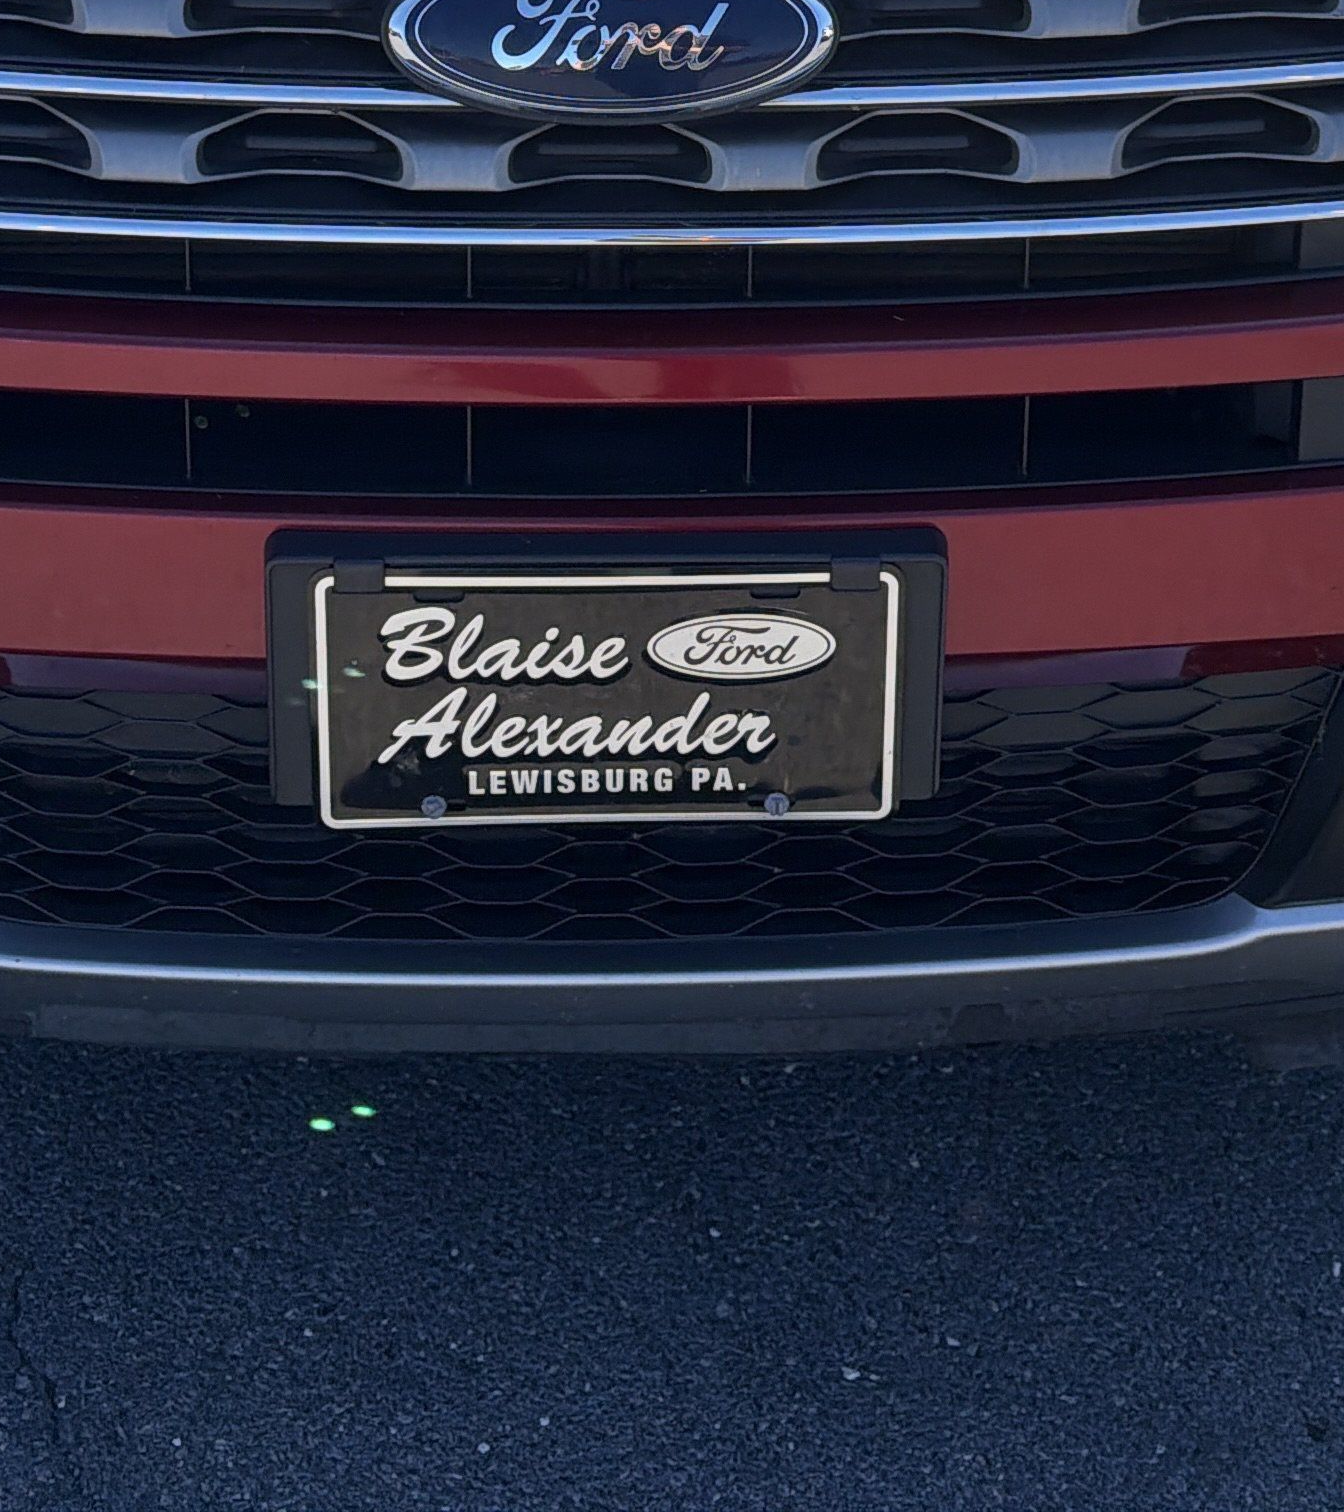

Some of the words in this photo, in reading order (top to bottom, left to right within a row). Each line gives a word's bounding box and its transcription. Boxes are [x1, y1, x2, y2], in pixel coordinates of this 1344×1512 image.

[379, 606, 630, 680] Blaise
[683, 625, 798, 667] Ford
[378, 687, 777, 764] Alexander
[468, 768, 674, 796] LEWISBURG
[692, 766, 748, 793] PA.
